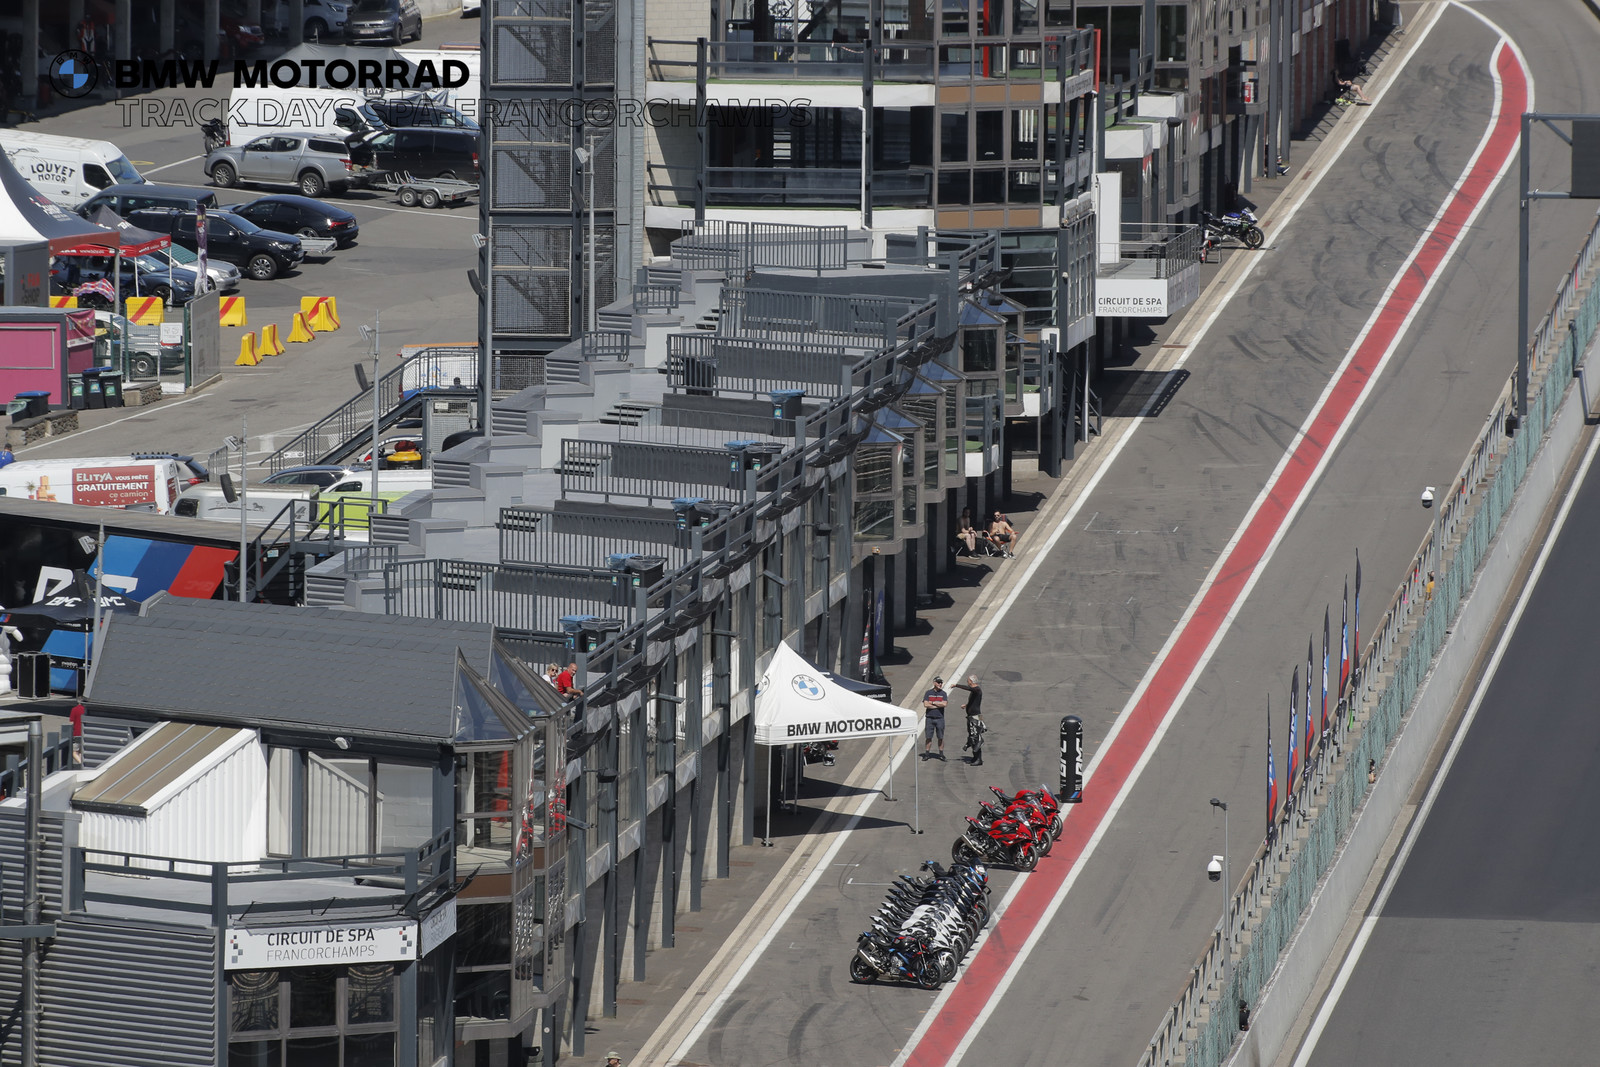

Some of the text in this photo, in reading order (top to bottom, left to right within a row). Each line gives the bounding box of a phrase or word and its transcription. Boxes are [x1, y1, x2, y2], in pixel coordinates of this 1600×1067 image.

[31, 163, 76, 177] LOUYET
[38, 173, 67, 184] MOTOR
[1098, 297, 1162, 306] CIRCUIT DE SPA
[1098, 306, 1163, 314] FRANCORCHAMPS
[77, 482, 149, 492] GRATUITEMENT
[787, 716, 902, 737] BMW MOTORRAD
[267, 927, 375, 947] CIRCUIT DE SPA
[266, 945, 376, 962] FRANCORCHAMPS
